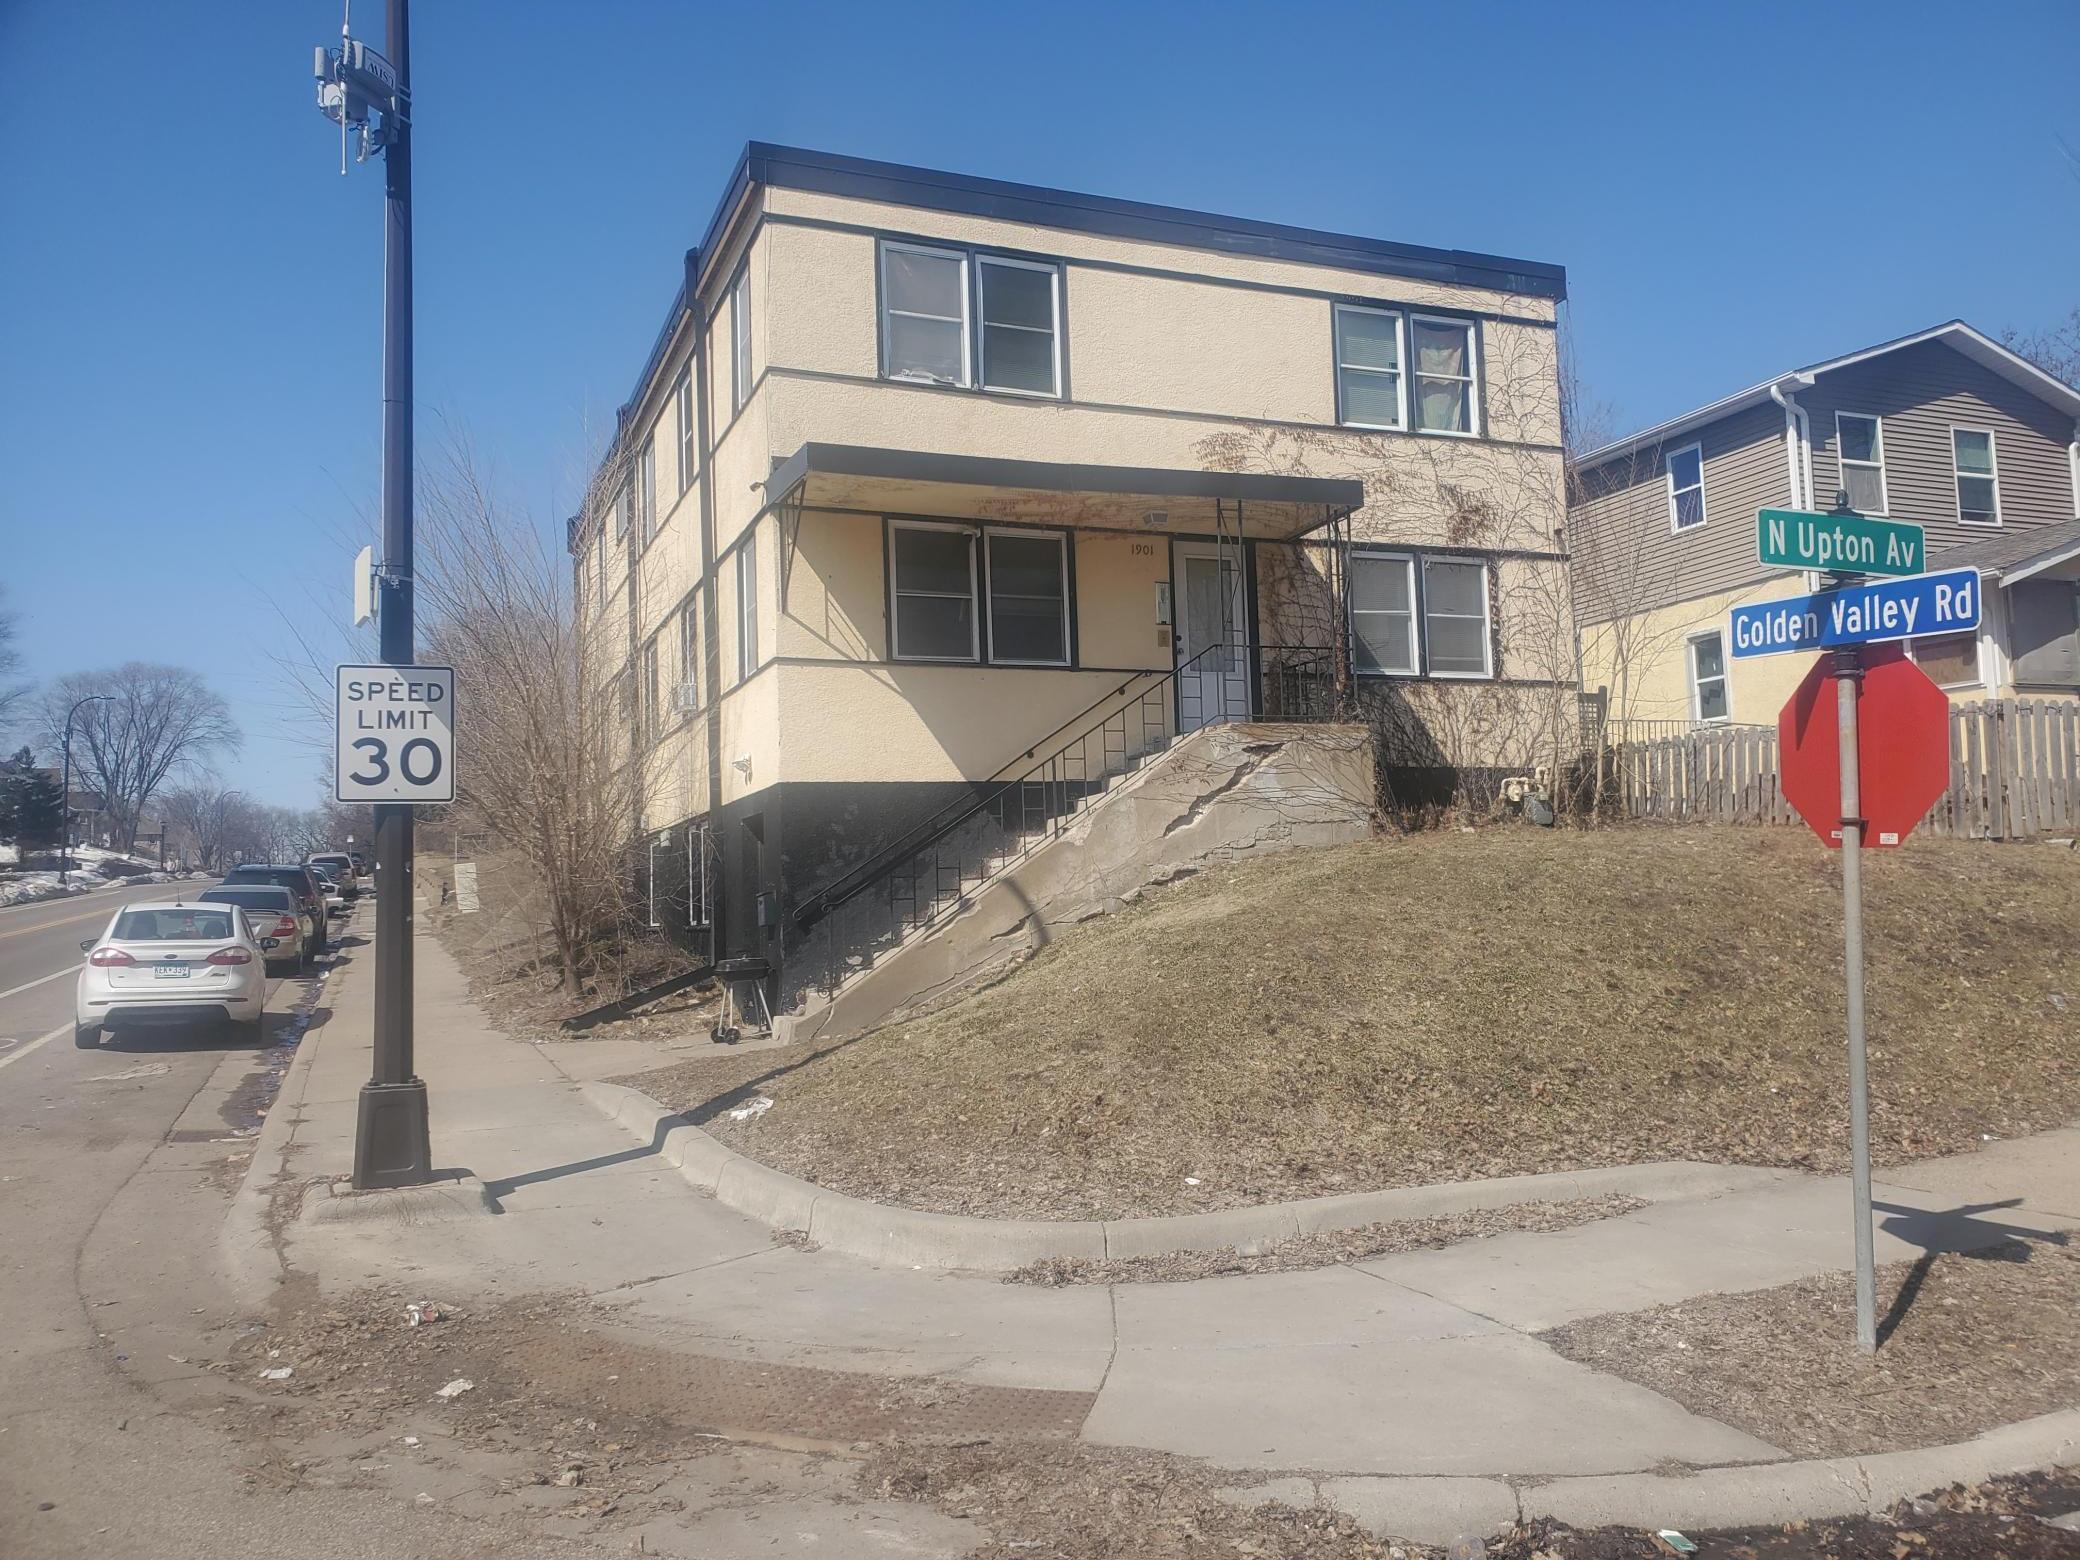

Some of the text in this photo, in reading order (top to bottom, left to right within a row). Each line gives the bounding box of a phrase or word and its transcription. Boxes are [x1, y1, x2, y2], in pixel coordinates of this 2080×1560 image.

[1131, 543, 1154, 556] 1901
[1768, 519, 1915, 568] N Upton Av
[1736, 580, 1973, 649] Golden Valley Rd
[347, 681, 444, 703] SPEED
[357, 709, 434, 730] LIMIT
[348, 736, 442, 786] 30
